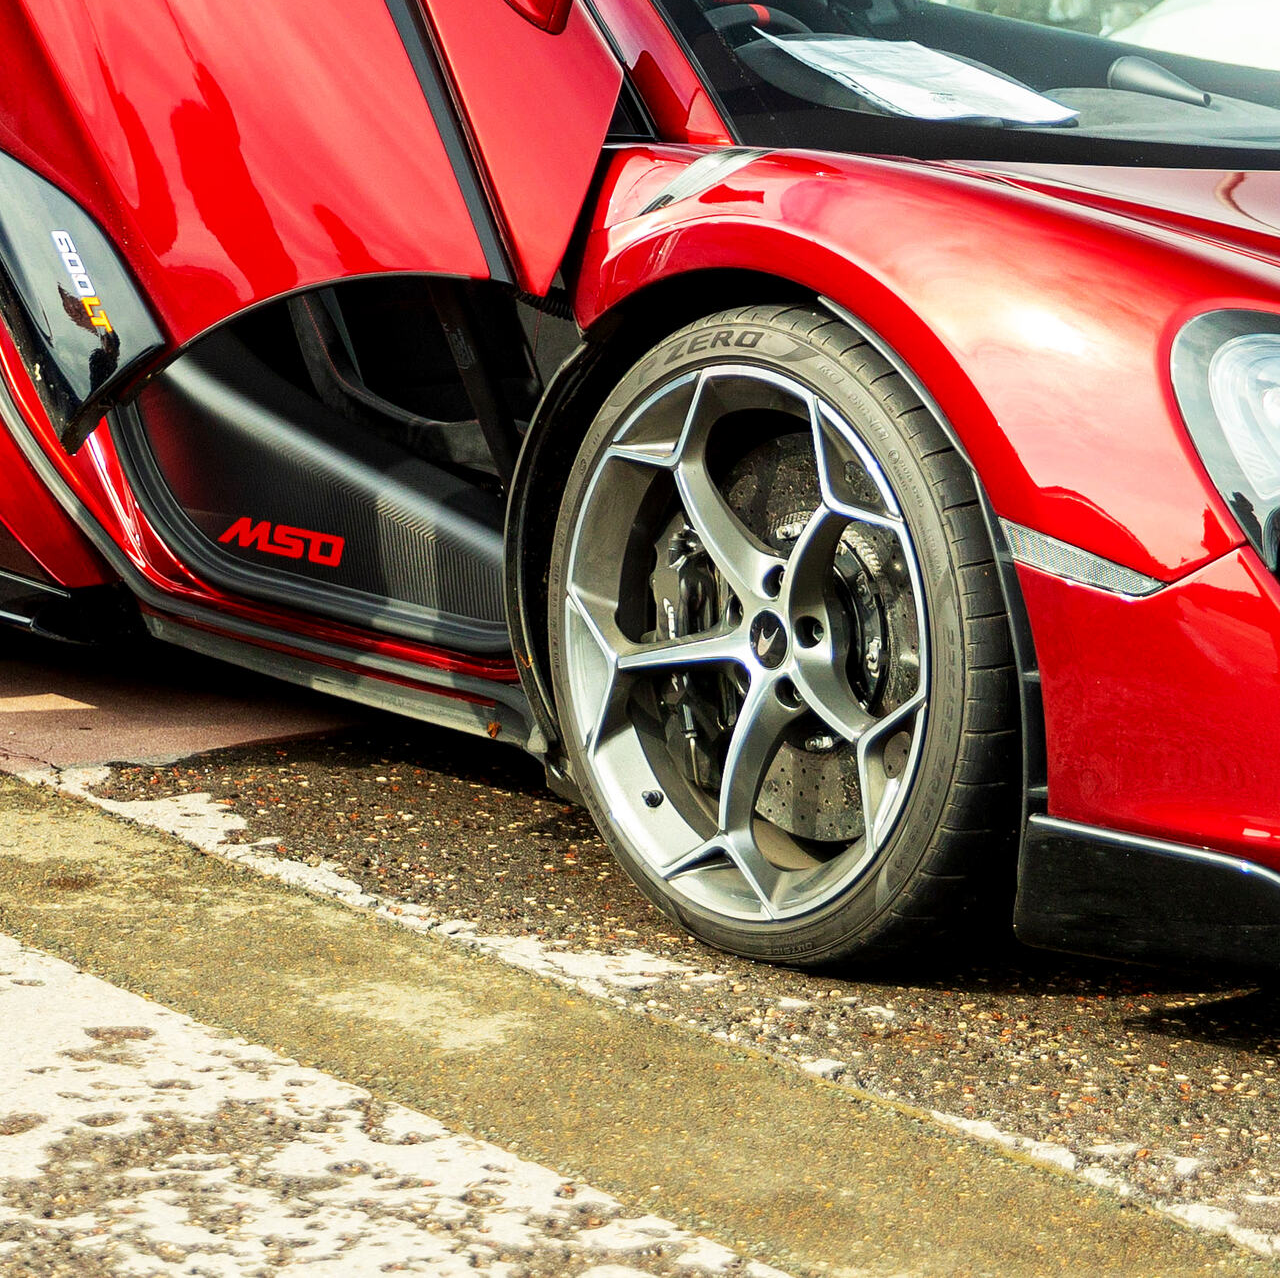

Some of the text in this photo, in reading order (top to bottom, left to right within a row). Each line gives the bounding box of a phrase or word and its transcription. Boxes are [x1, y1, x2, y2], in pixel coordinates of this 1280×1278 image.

[51, 230, 113, 333] 600LT
[664, 330, 765, 365] ZERO
[217, 517, 345, 567] MSO
